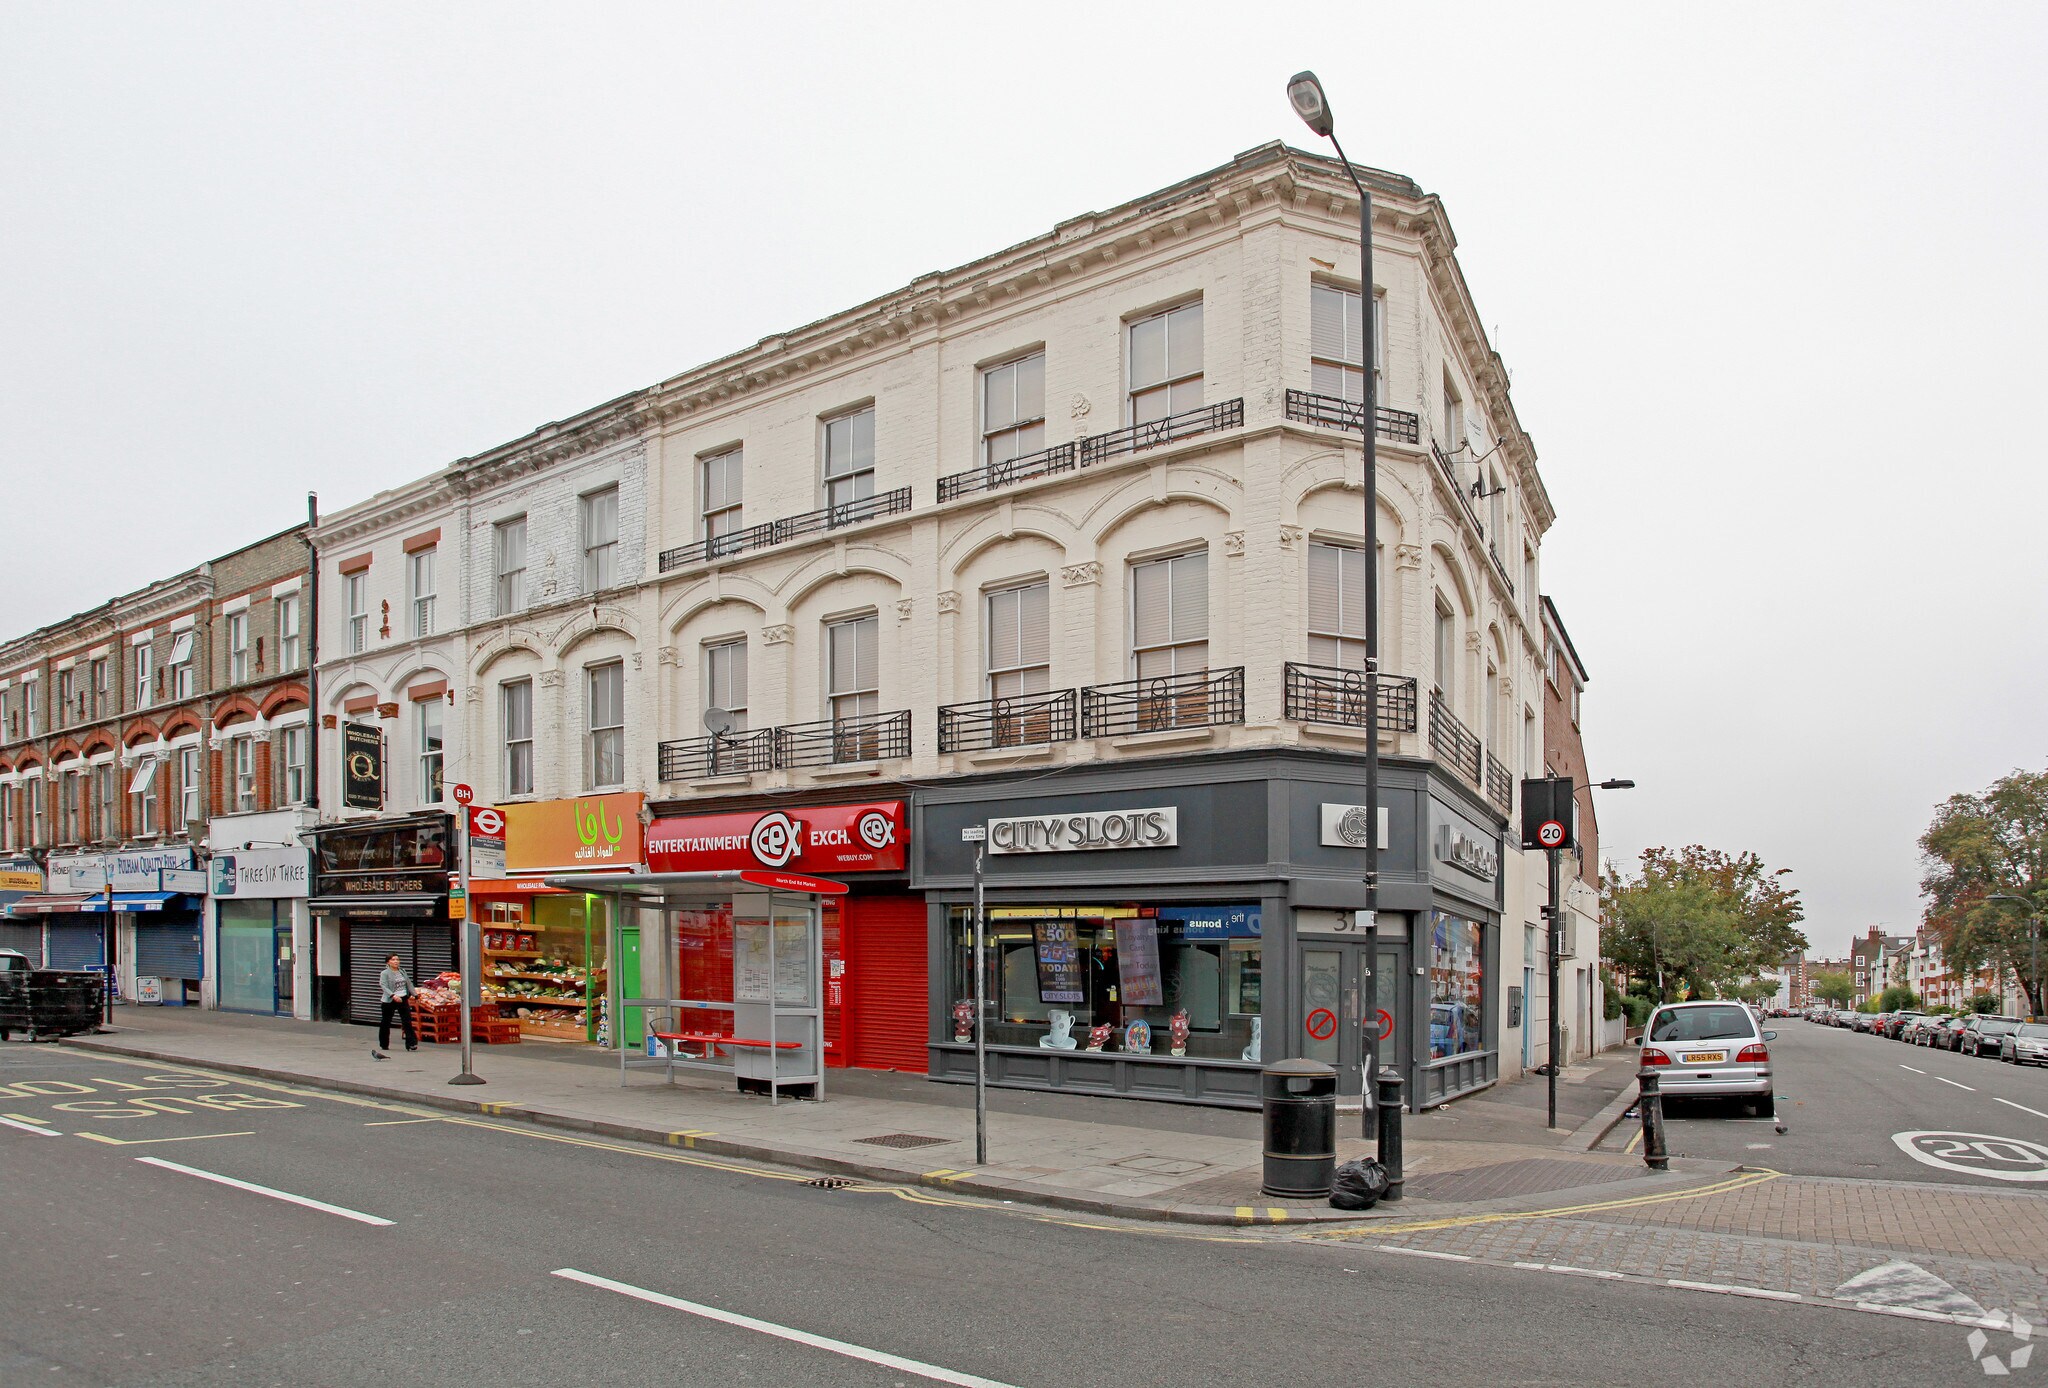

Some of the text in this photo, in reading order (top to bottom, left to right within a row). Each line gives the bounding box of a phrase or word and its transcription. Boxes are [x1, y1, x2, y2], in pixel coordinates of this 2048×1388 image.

[347, 730, 380, 740] WHOLESALE
[350, 736, 378, 745] BUTCHERS
[456, 790, 471, 799] BH
[991, 812, 1169, 849] CITY SLOTS
[1543, 829, 1560, 838] 20
[648, 834, 750, 854] ENTERTAINMENT
[810, 829, 852, 846] EXCH
[118, 858, 140, 874] FULHAM
[164, 854, 176, 868] FISH
[52, 866, 70, 874] PHONES
[240, 864, 304, 882] THREE SIX THREE
[346, 880, 422, 891] WHOLESALE BUTCHERS
[1036, 929, 1074, 941] £500
[1040, 964, 1078, 972] TODAY!
[1136, 962, 1158, 971] Today
[1687, 1054, 1706, 1062] LR55
[52, 1094, 306, 1118] BUS
[1920, 1140, 2044, 1164] 20
